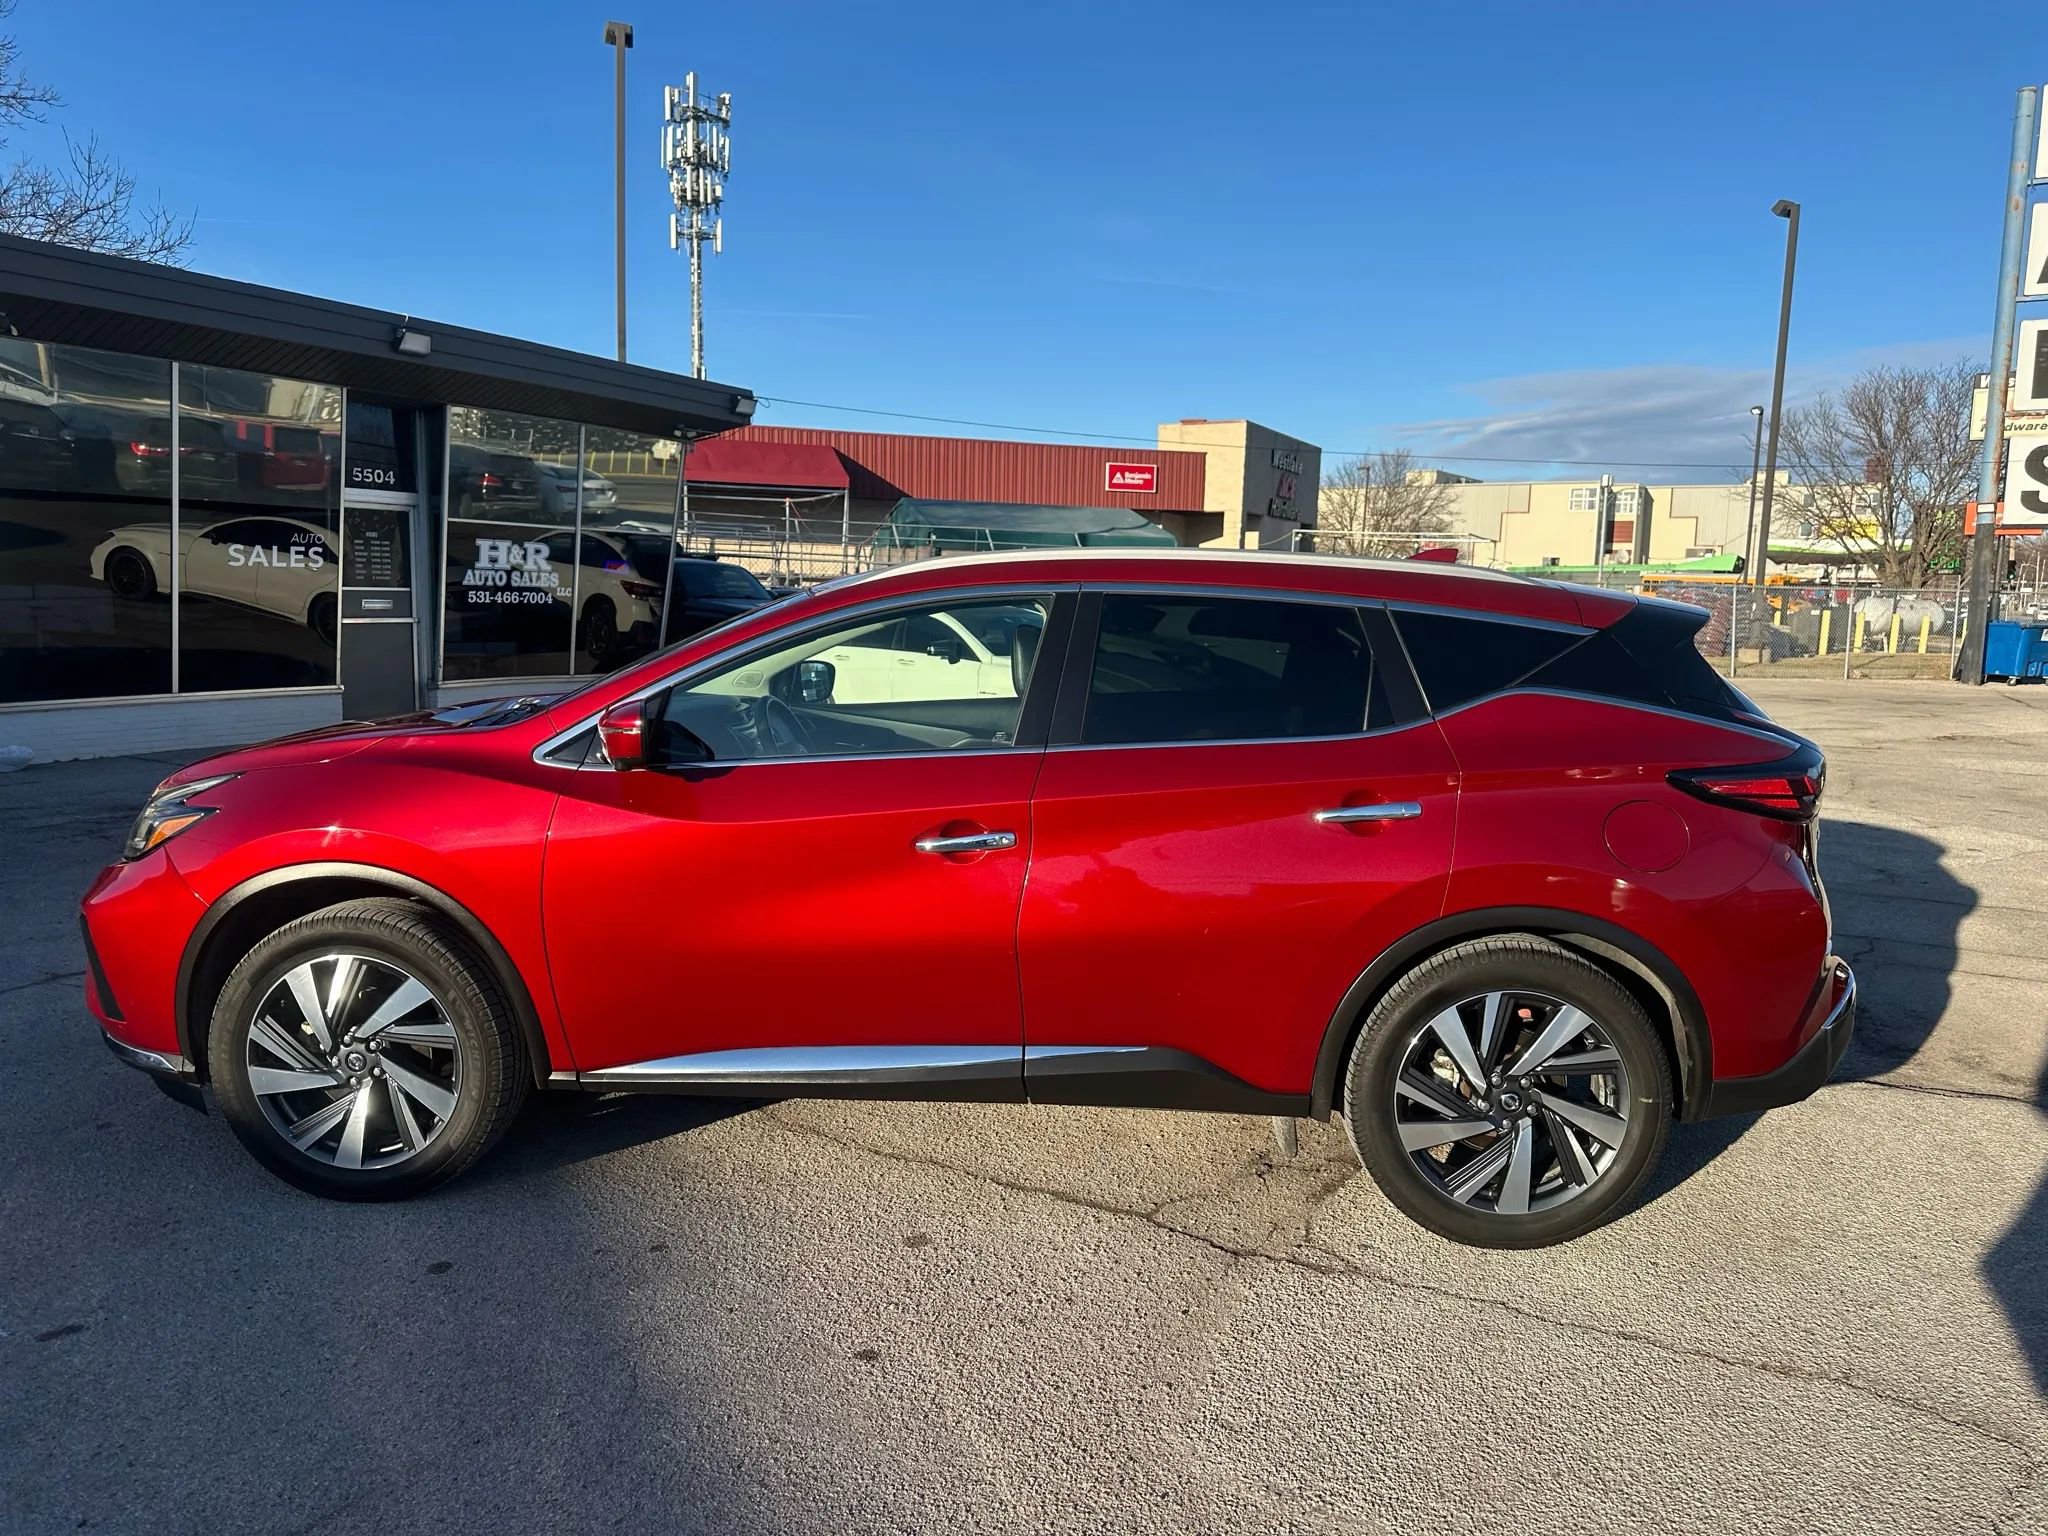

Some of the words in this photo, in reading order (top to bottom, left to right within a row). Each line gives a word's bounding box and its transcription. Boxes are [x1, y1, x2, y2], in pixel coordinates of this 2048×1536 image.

[352, 467, 396, 485] 5504
[290, 533, 325, 544] AUTO
[228, 544, 324, 568] SALES
[475, 538, 552, 571] H&R
[462, 569, 507, 586] AUTO
[511, 571, 560, 587] SALES
[468, 590, 553, 604] 531-466-7004
[556, 587, 572, 597] LLC
